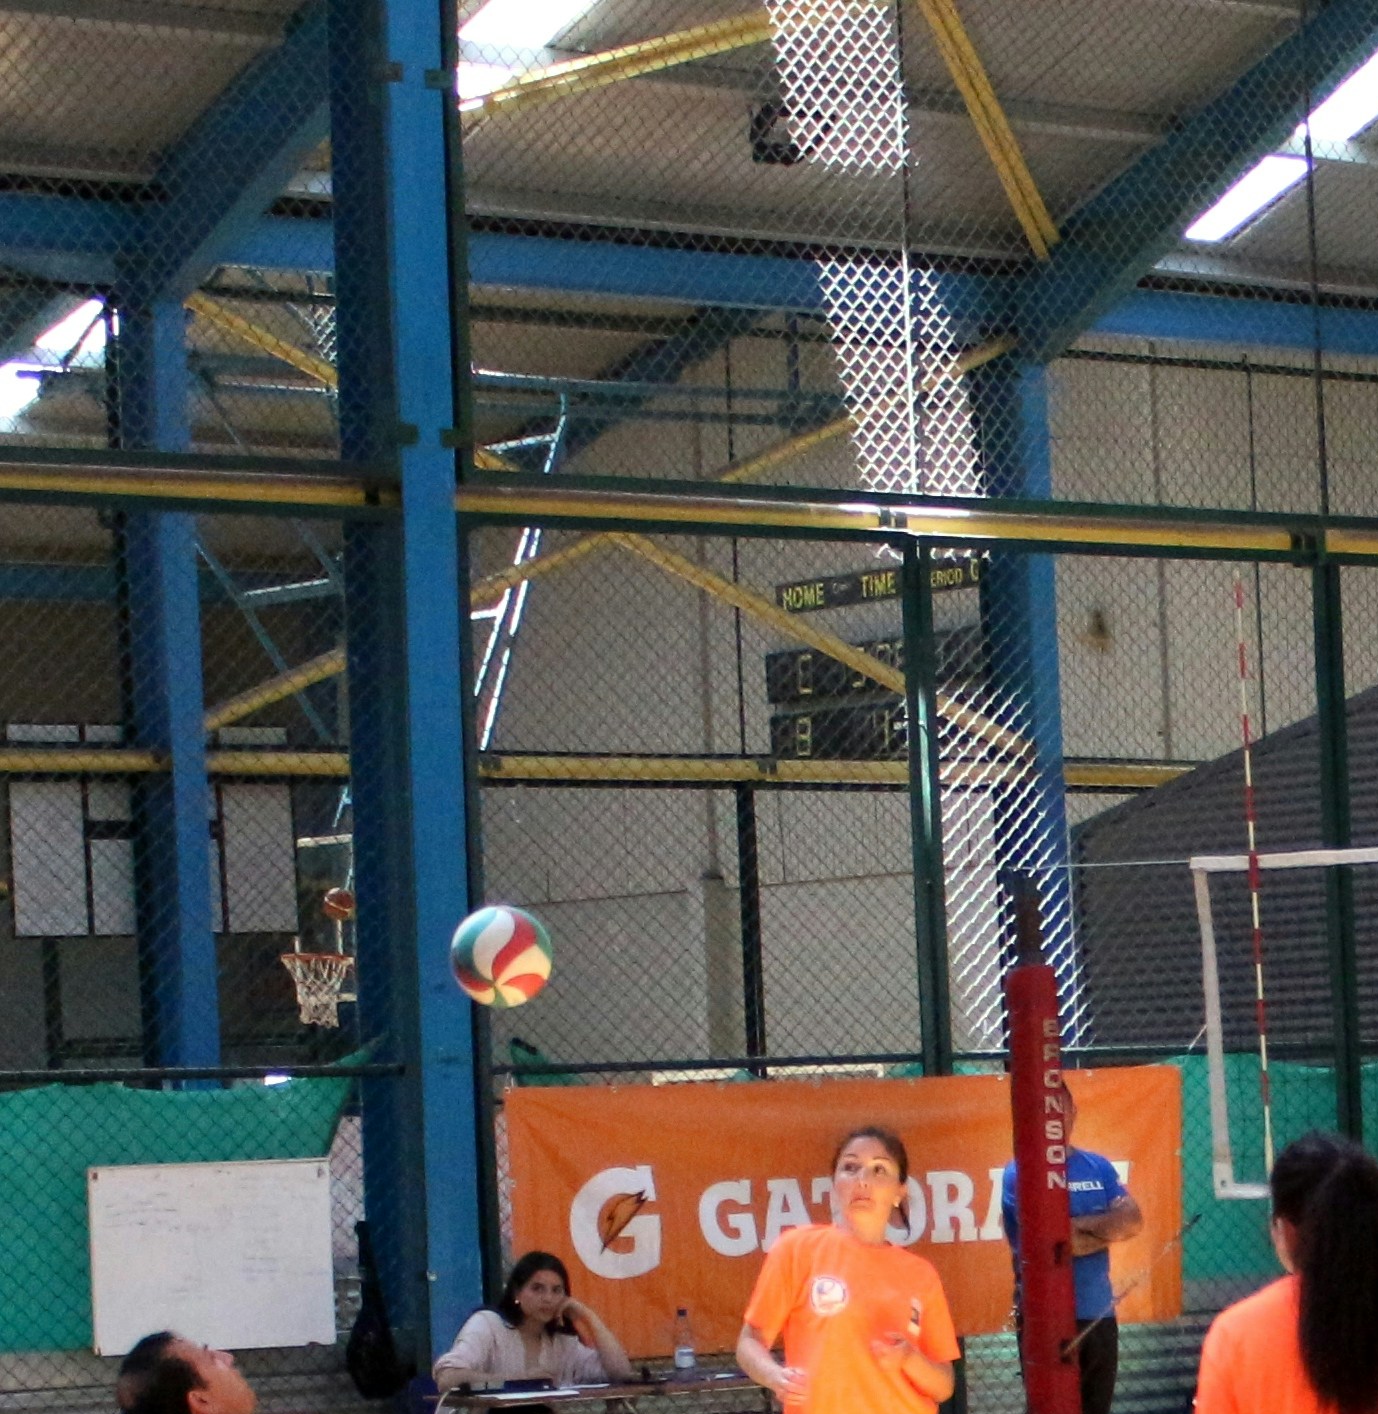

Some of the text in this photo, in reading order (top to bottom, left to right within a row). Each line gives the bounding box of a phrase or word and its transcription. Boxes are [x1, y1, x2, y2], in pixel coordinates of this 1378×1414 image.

[782, 583, 825, 612] HOME
[860, 570, 897, 599] TIME
[931, 567, 964, 588] ERIOD
[570, 1164, 663, 1280] G
